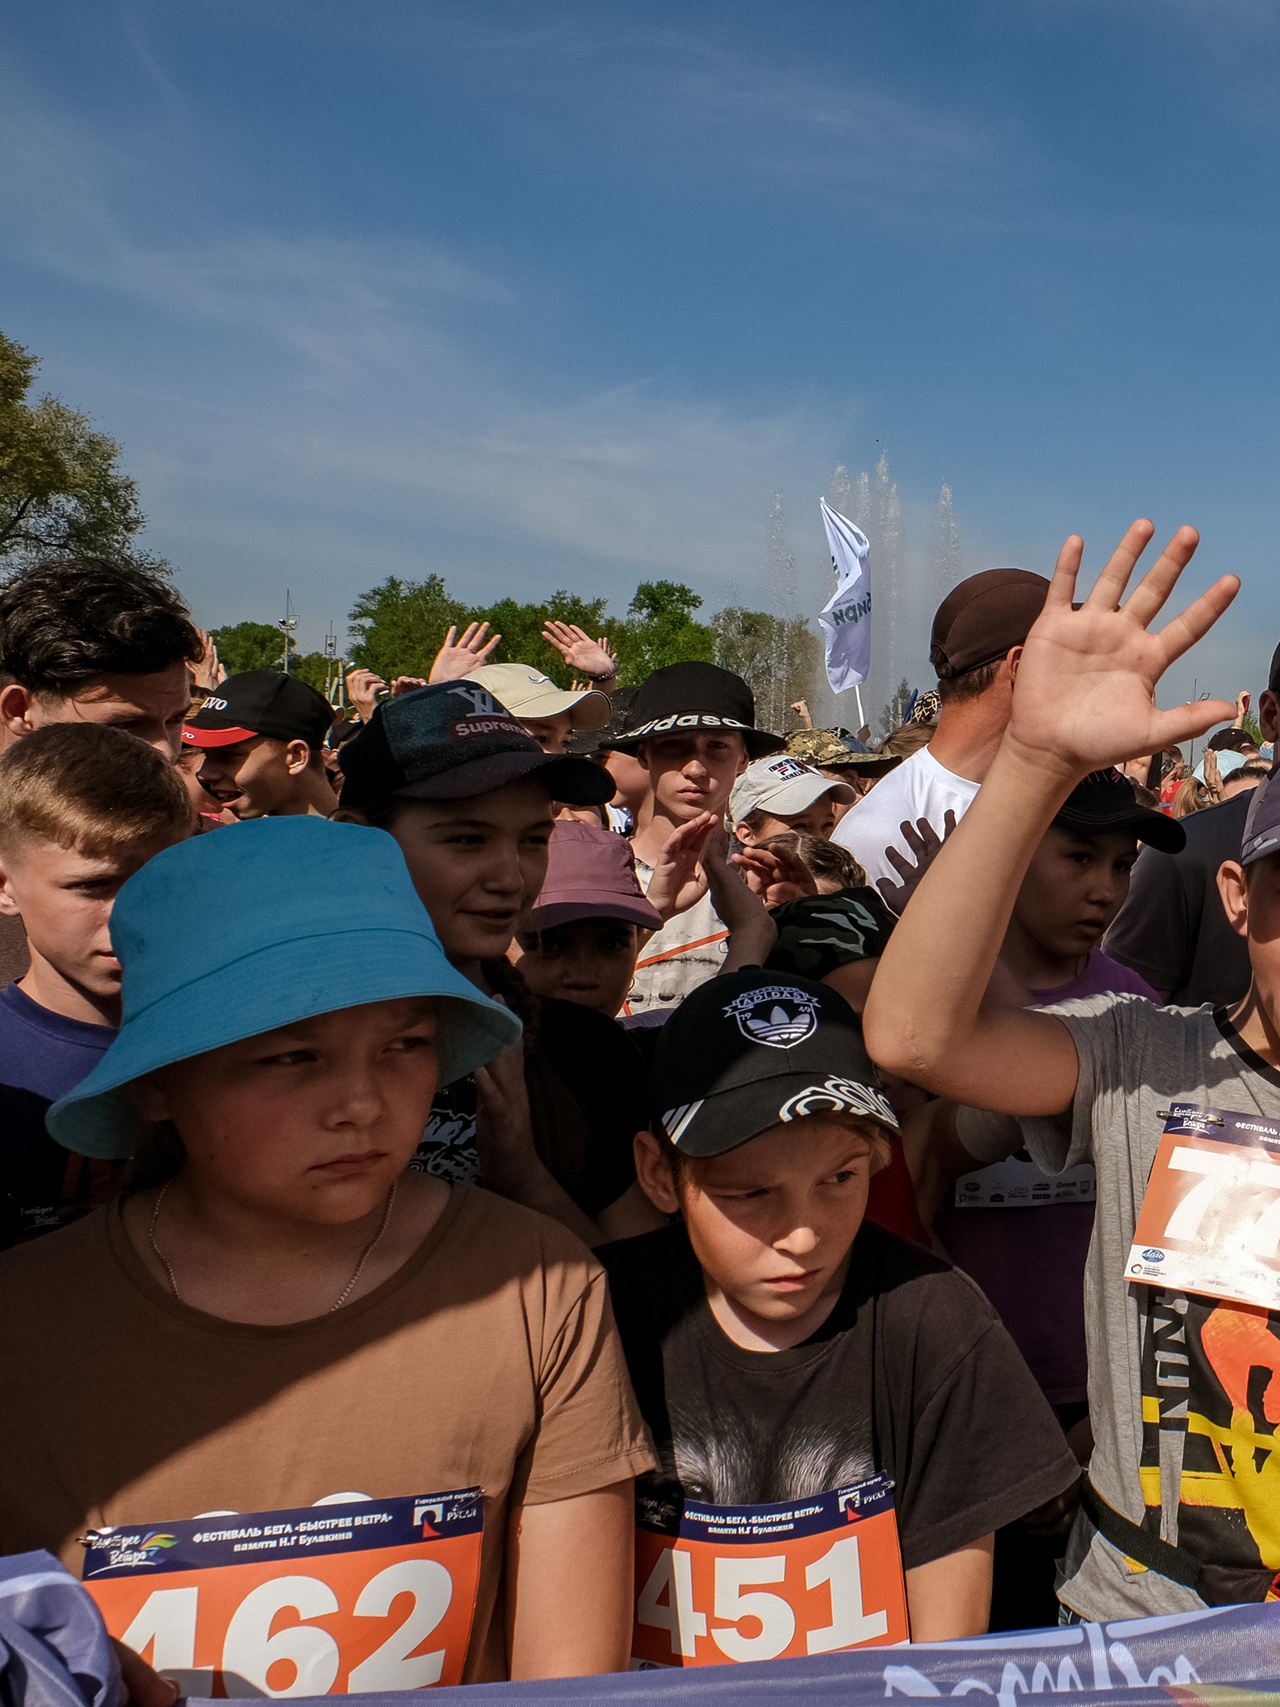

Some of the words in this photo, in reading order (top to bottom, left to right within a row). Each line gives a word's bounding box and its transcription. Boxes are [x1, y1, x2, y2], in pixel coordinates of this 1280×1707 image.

[1235, 1121, 1278, 1136] ФЕСТИВАЛЬ
[192, 1528, 262, 1544] ФЕСТИВАЛЬ
[264, 1522, 293, 1538] БЕГА
[294, 1516, 353, 1533] «БЫСТРЕЕ
[354, 1513, 394, 1527] ВЕТРА»
[684, 1510, 725, 1525] ФЕСТИВАЛЬ
[726, 1515, 748, 1525] БЕГА
[233, 1539, 277, 1552] памяти
[299, 1531, 352, 1547] Булакина
[637, 1535, 888, 1663] 451
[121, 1558, 453, 1699] 462
